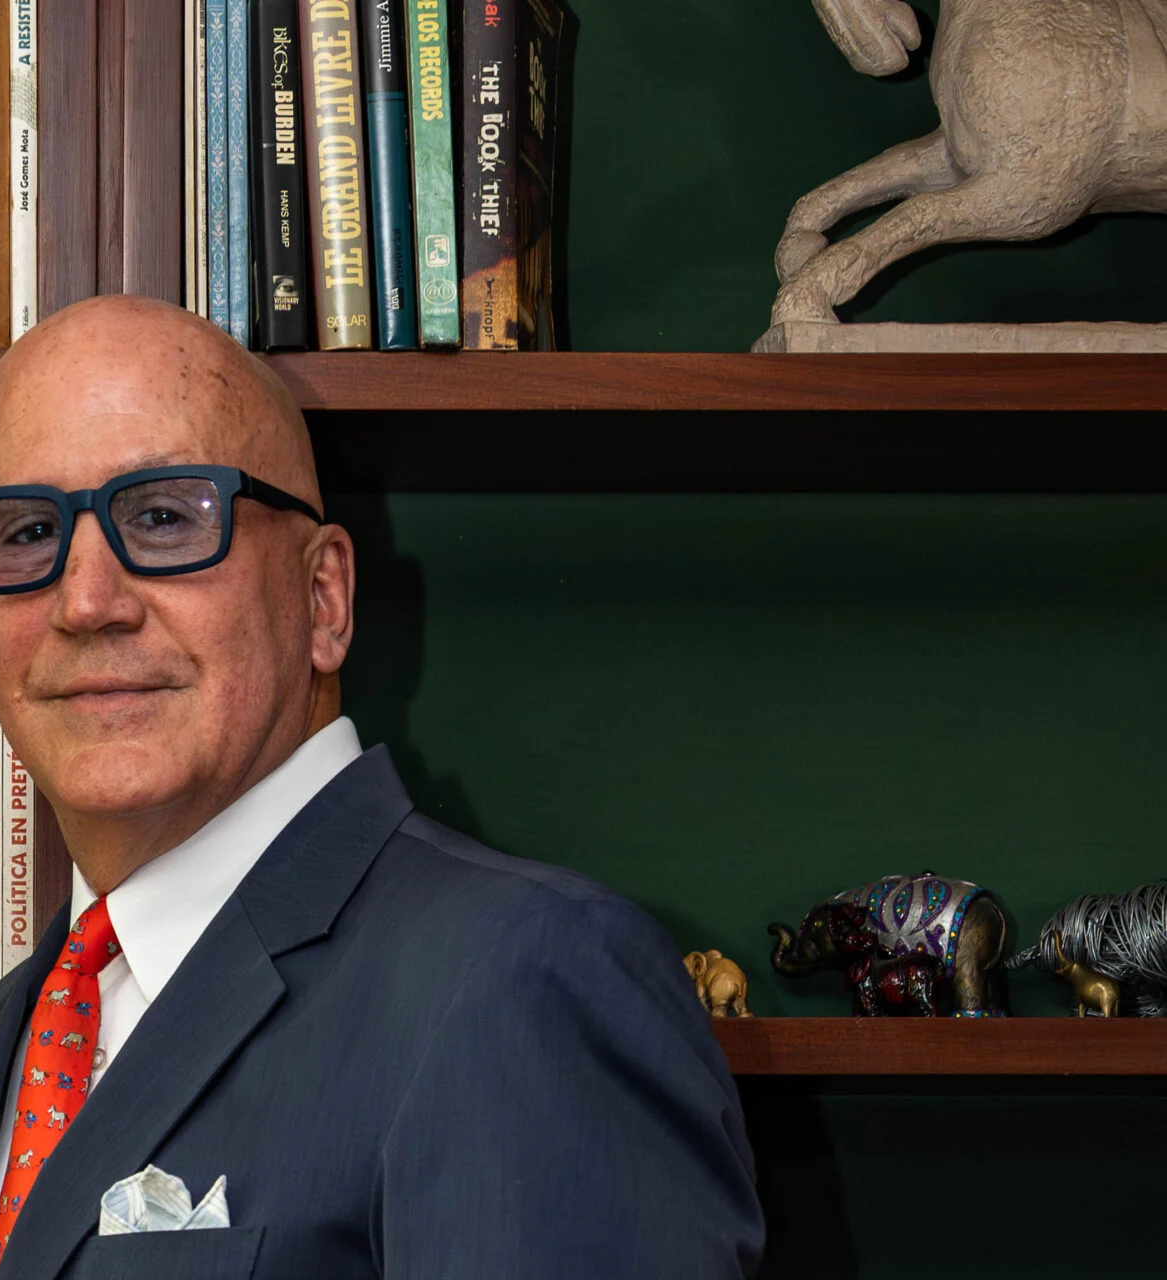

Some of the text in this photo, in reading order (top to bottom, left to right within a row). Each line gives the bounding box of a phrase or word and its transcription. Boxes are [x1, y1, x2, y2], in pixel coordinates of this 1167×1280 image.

[418, 12, 444, 121] LOS RECORDS
[274, 90, 295, 165] BURDEN
[311, 30, 364, 289] LE GRAND LIVRE
[480, 63, 503, 237] THE BOOK THIEF
[19, 129, 29, 212] José Gomes Mota
[280, 189, 290, 247] HANS KEMP
[326, 315, 367, 328] SOLAR
